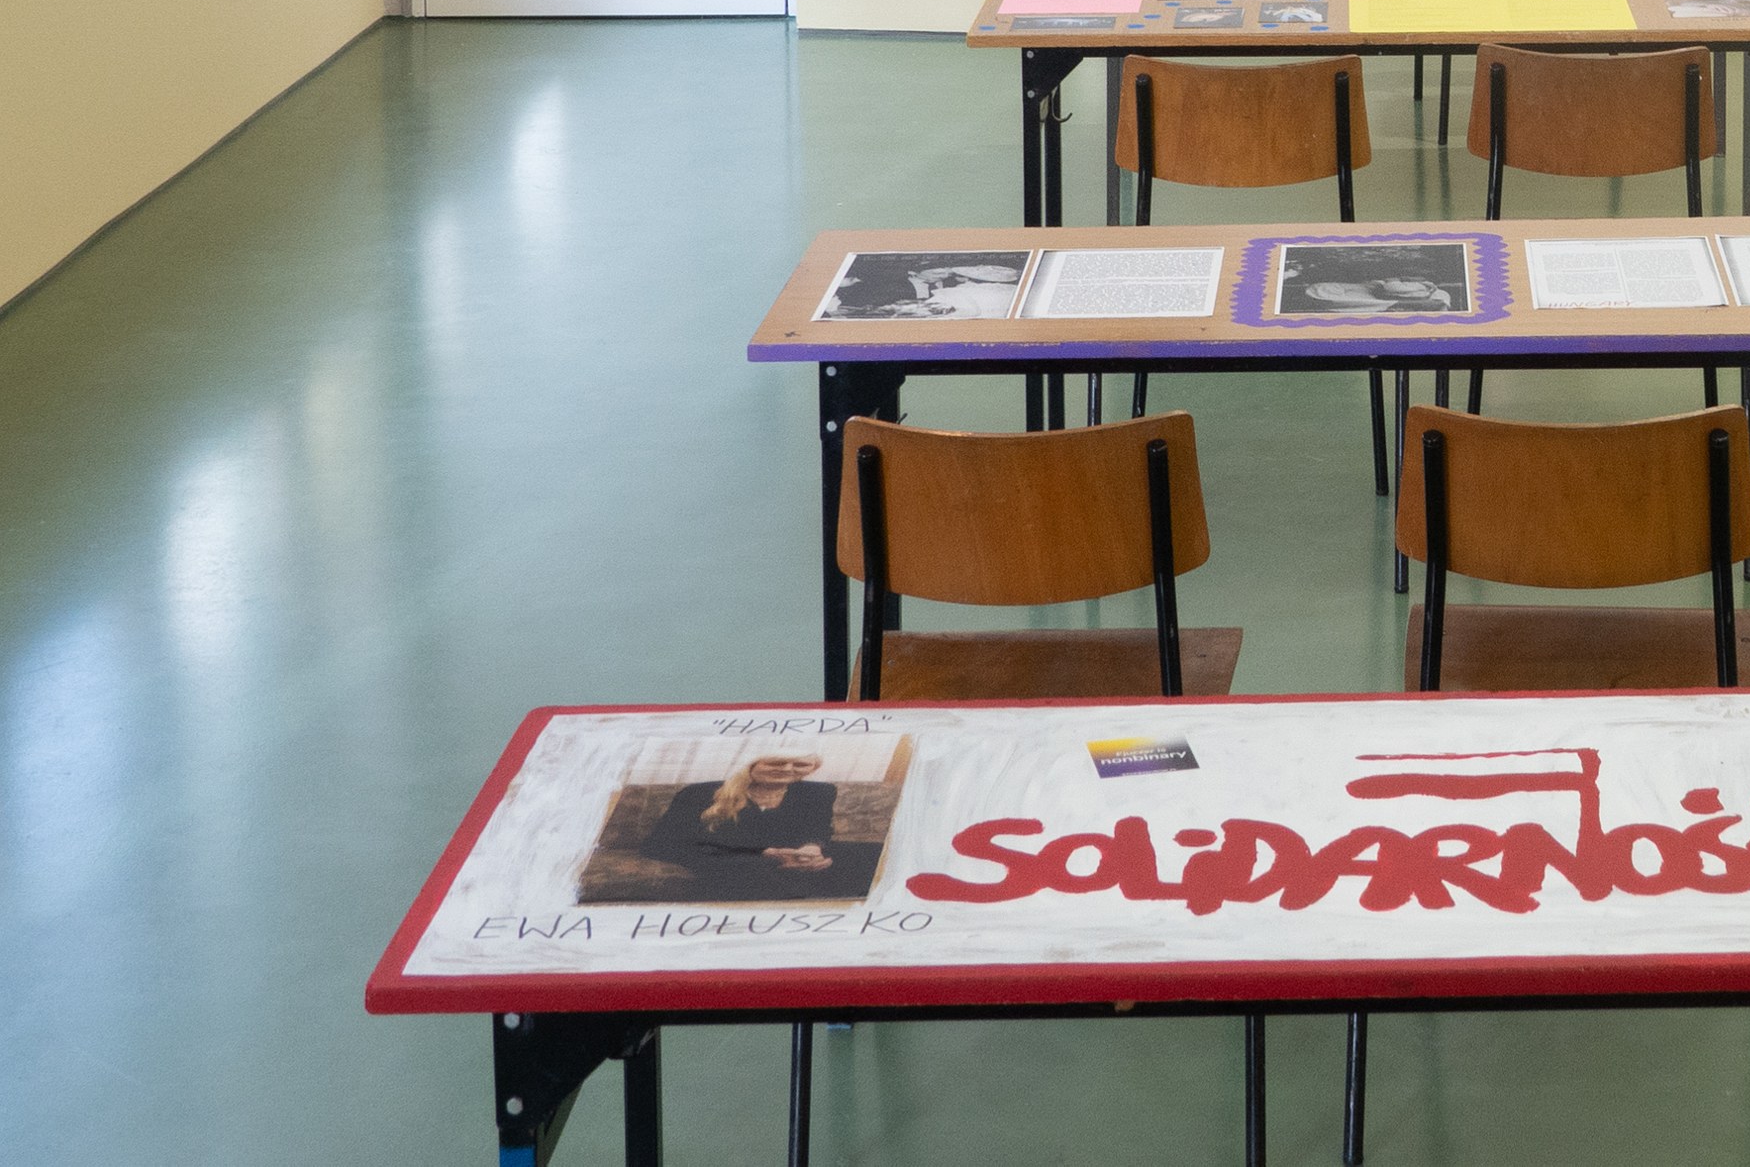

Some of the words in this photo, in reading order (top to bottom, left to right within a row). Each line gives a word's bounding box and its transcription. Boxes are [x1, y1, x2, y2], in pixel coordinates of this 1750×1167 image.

[713, 714, 893, 734] "HARDA"
[1100, 751, 1187, 765] nonbinary
[472, 915, 593, 940] EWA
[630, 911, 934, 940] HOŁUSZKO
